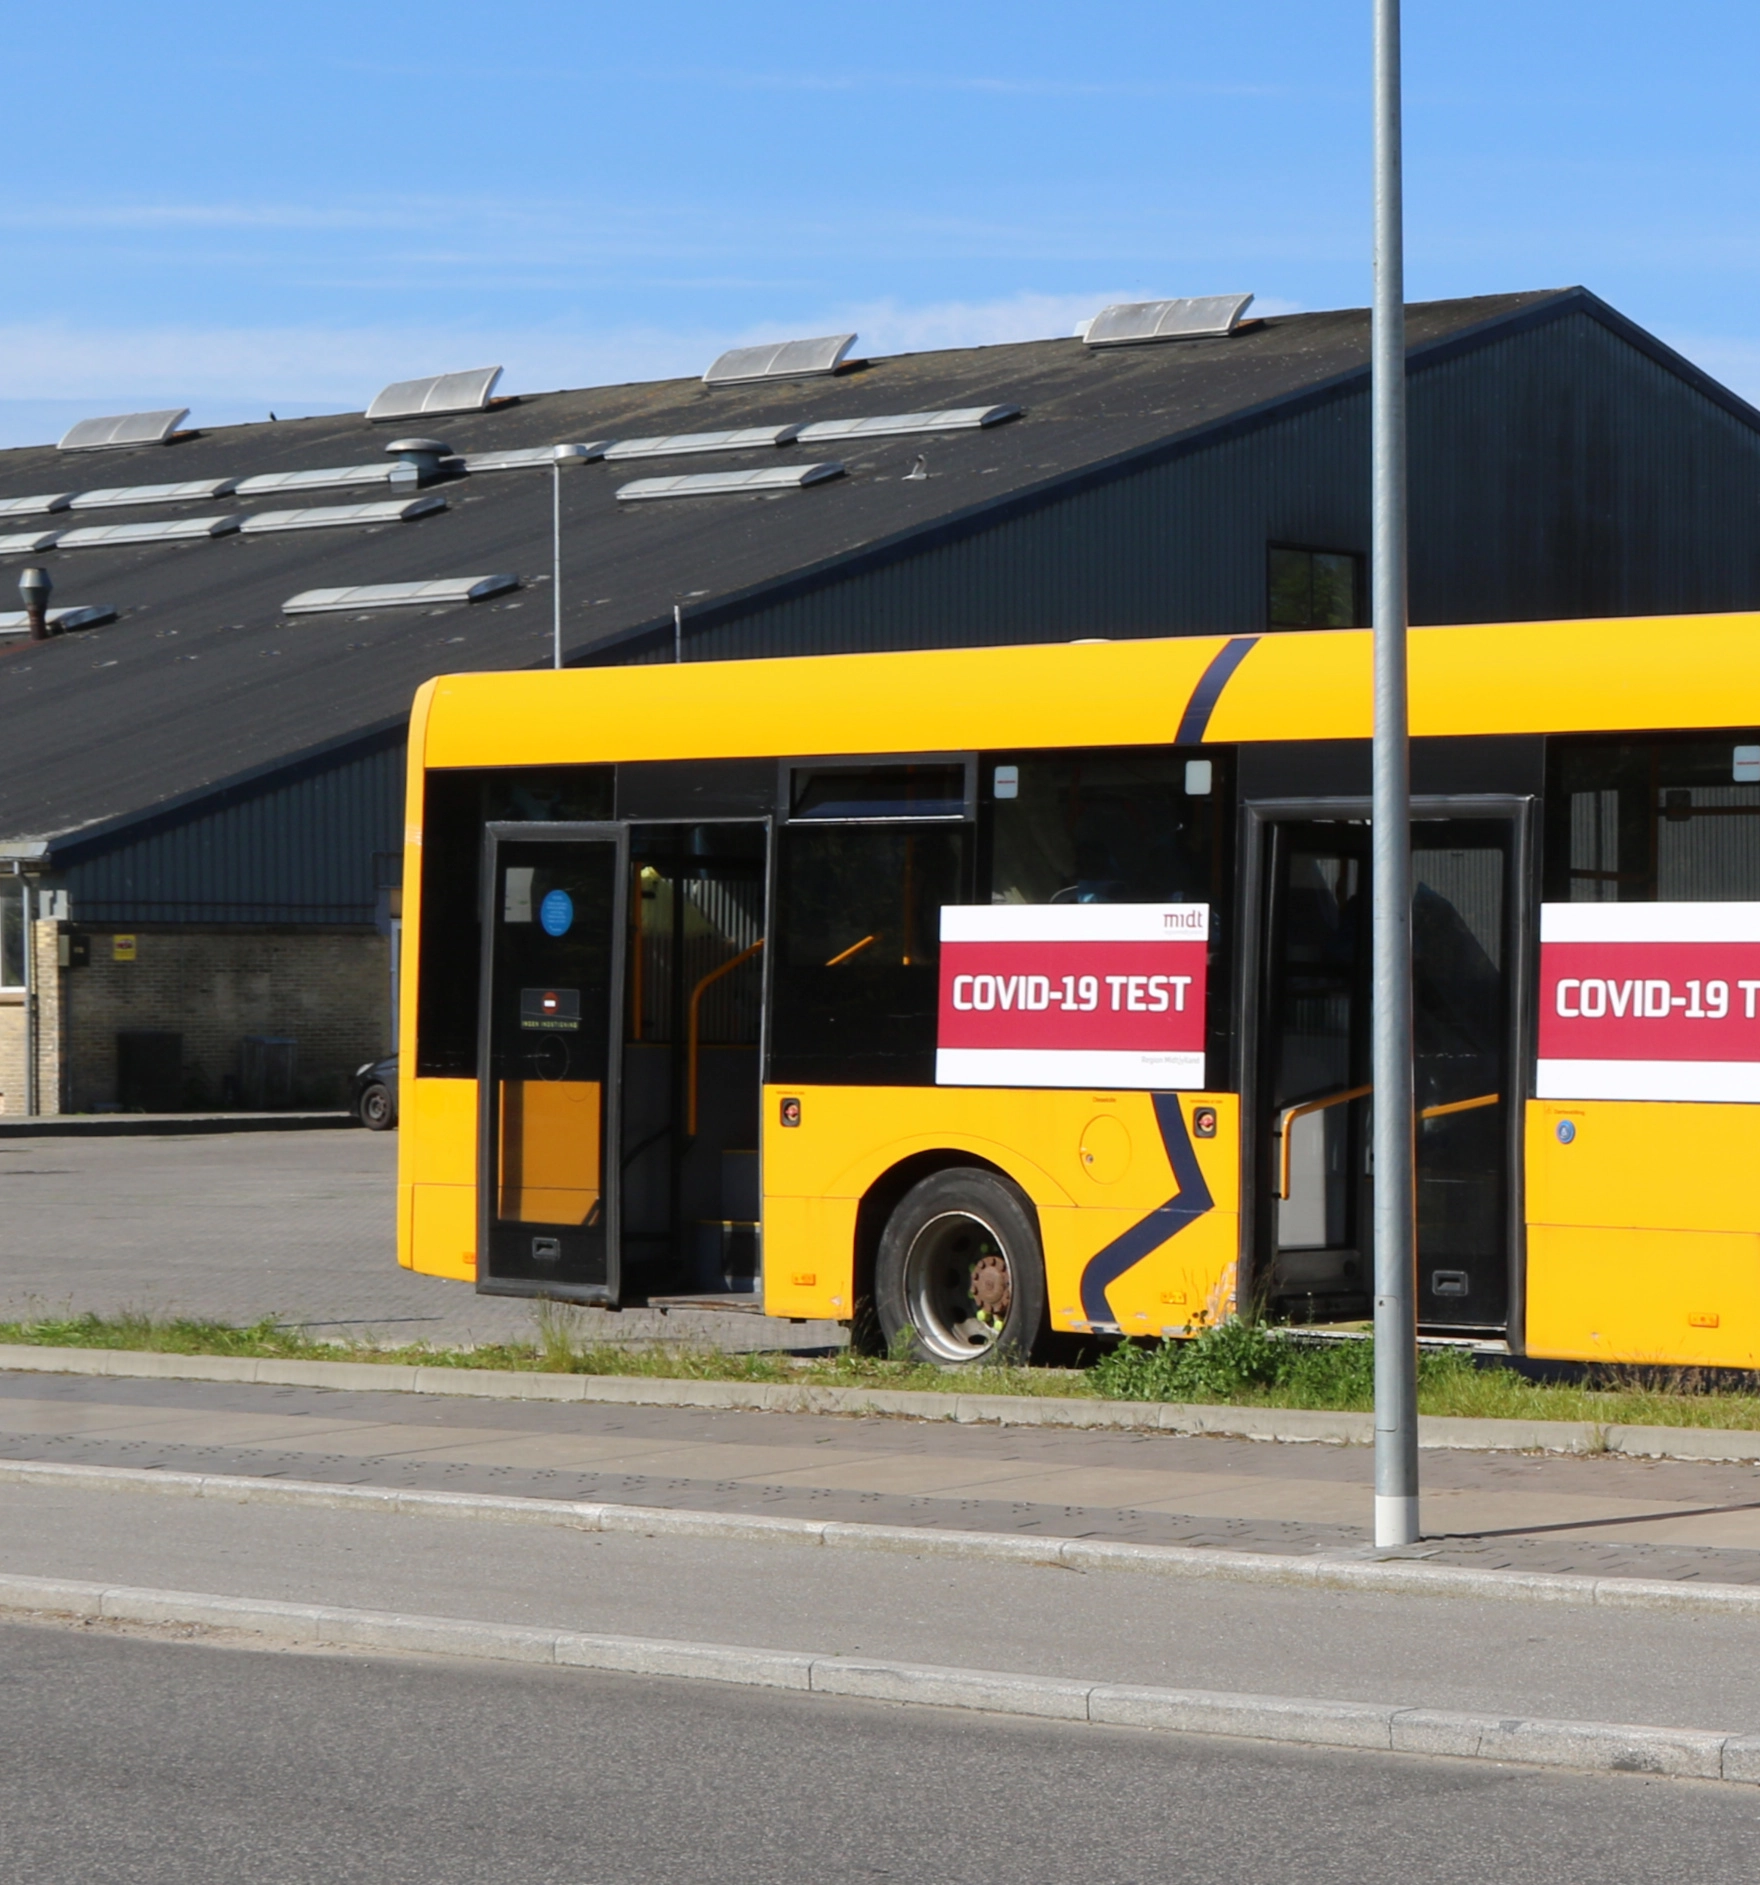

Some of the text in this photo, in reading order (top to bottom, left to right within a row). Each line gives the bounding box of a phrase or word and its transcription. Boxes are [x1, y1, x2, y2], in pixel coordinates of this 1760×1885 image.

[1163, 909, 1203, 928] midt
[952, 974, 1192, 1012] COVID-19 TEST
[1556, 978, 1729, 1018] COVID-19
